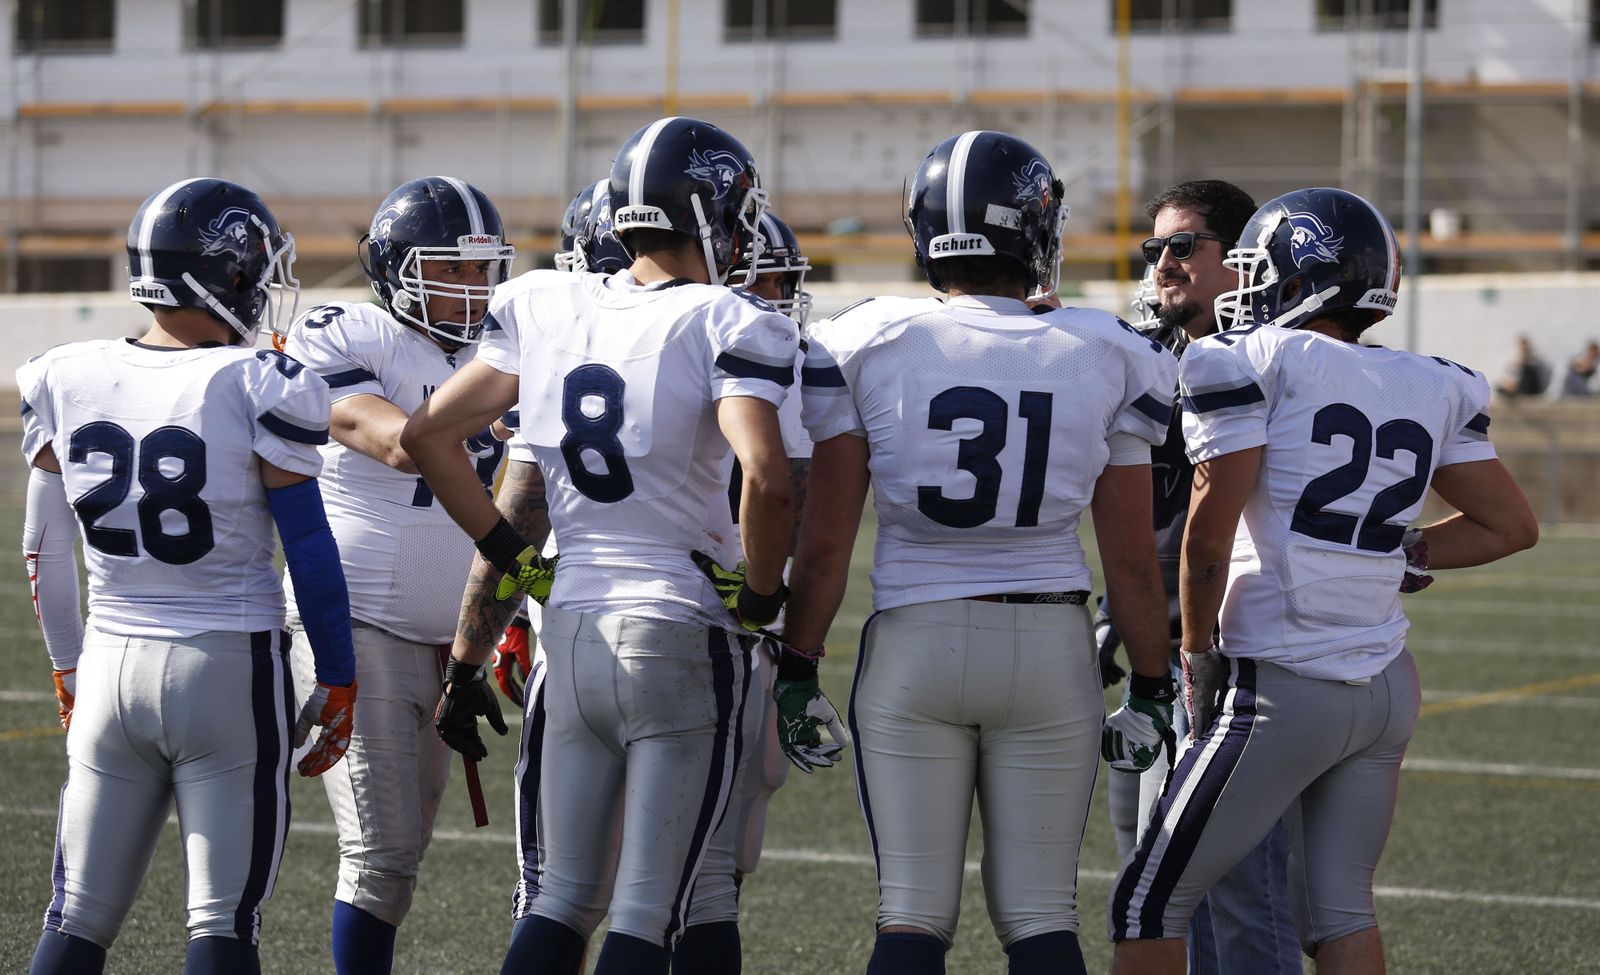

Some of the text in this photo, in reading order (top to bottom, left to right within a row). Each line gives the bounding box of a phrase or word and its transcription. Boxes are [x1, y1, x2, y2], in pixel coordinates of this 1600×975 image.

[618, 209, 659, 223] schutt
[934, 237, 983, 252] schutt
[131, 285, 165, 299] schutt
[68, 420, 216, 566] 28
[559, 363, 635, 504] 8
[916, 385, 1054, 529] 31
[1289, 402, 1434, 553] 22
